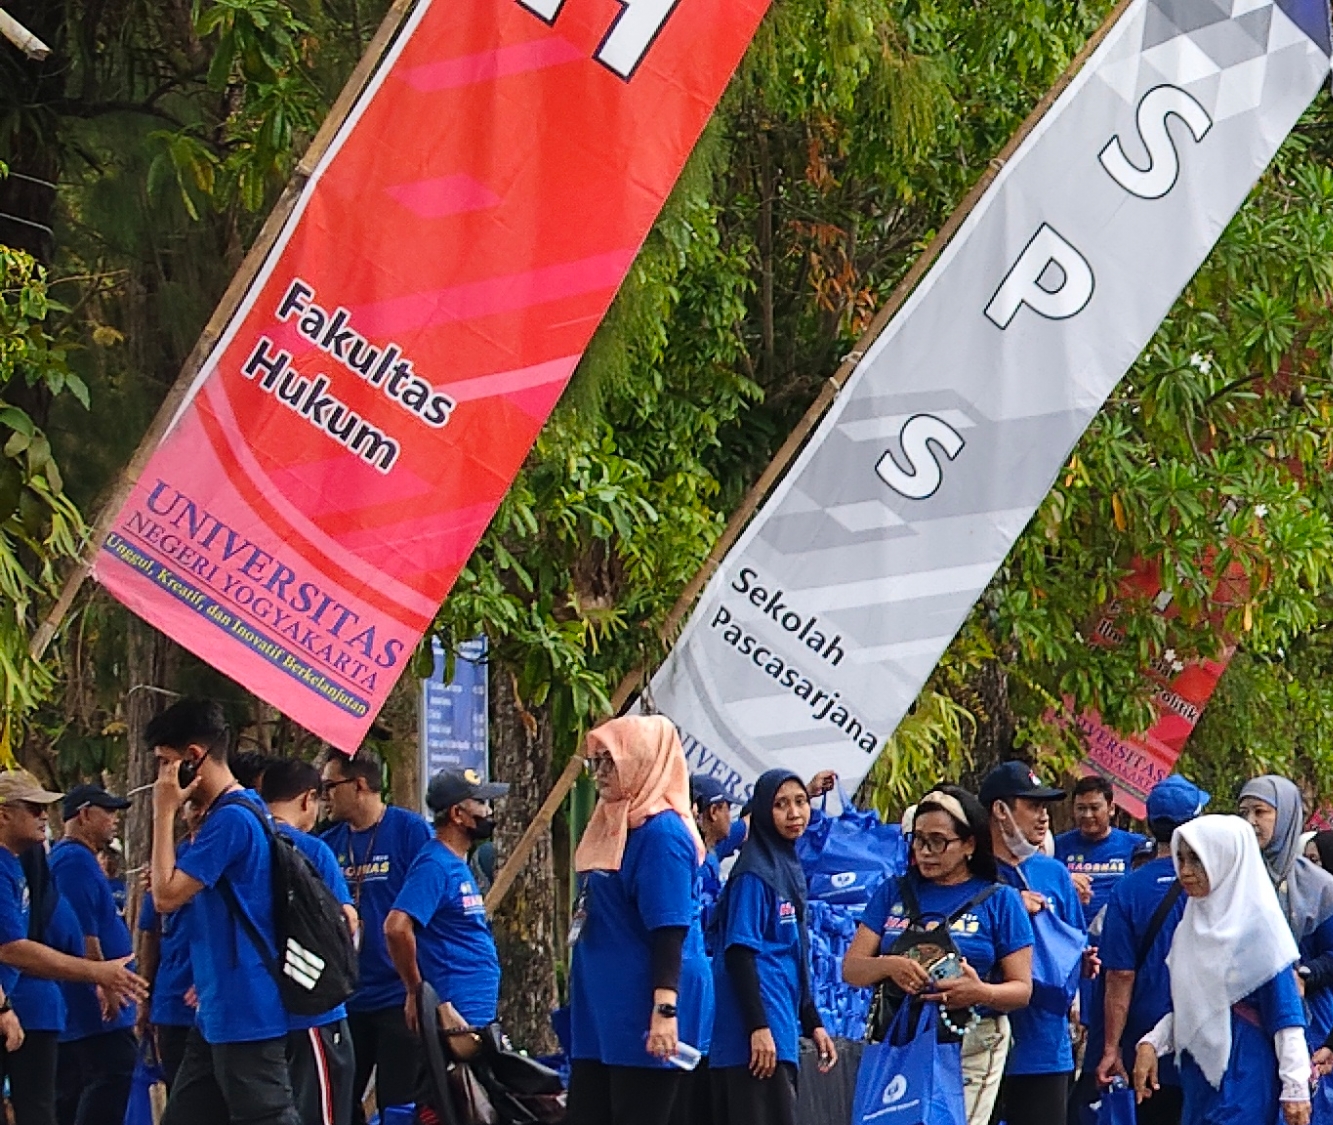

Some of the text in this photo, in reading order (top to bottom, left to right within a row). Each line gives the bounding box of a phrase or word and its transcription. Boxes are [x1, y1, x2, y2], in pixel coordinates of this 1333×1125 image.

[243, 338, 399, 471] Hukum
[276, 279, 454, 426] Fakultas
[106, 534, 367, 716] Unggul, Kreatif, dan Inovatif Berkelanjutan
[126, 510, 378, 690] NEGERI YOGYAKARTA
[146, 478, 405, 669] UNIVERSITAS
[731, 567, 845, 666] Sekolah
[711, 604, 878, 754] Pascasarjana
